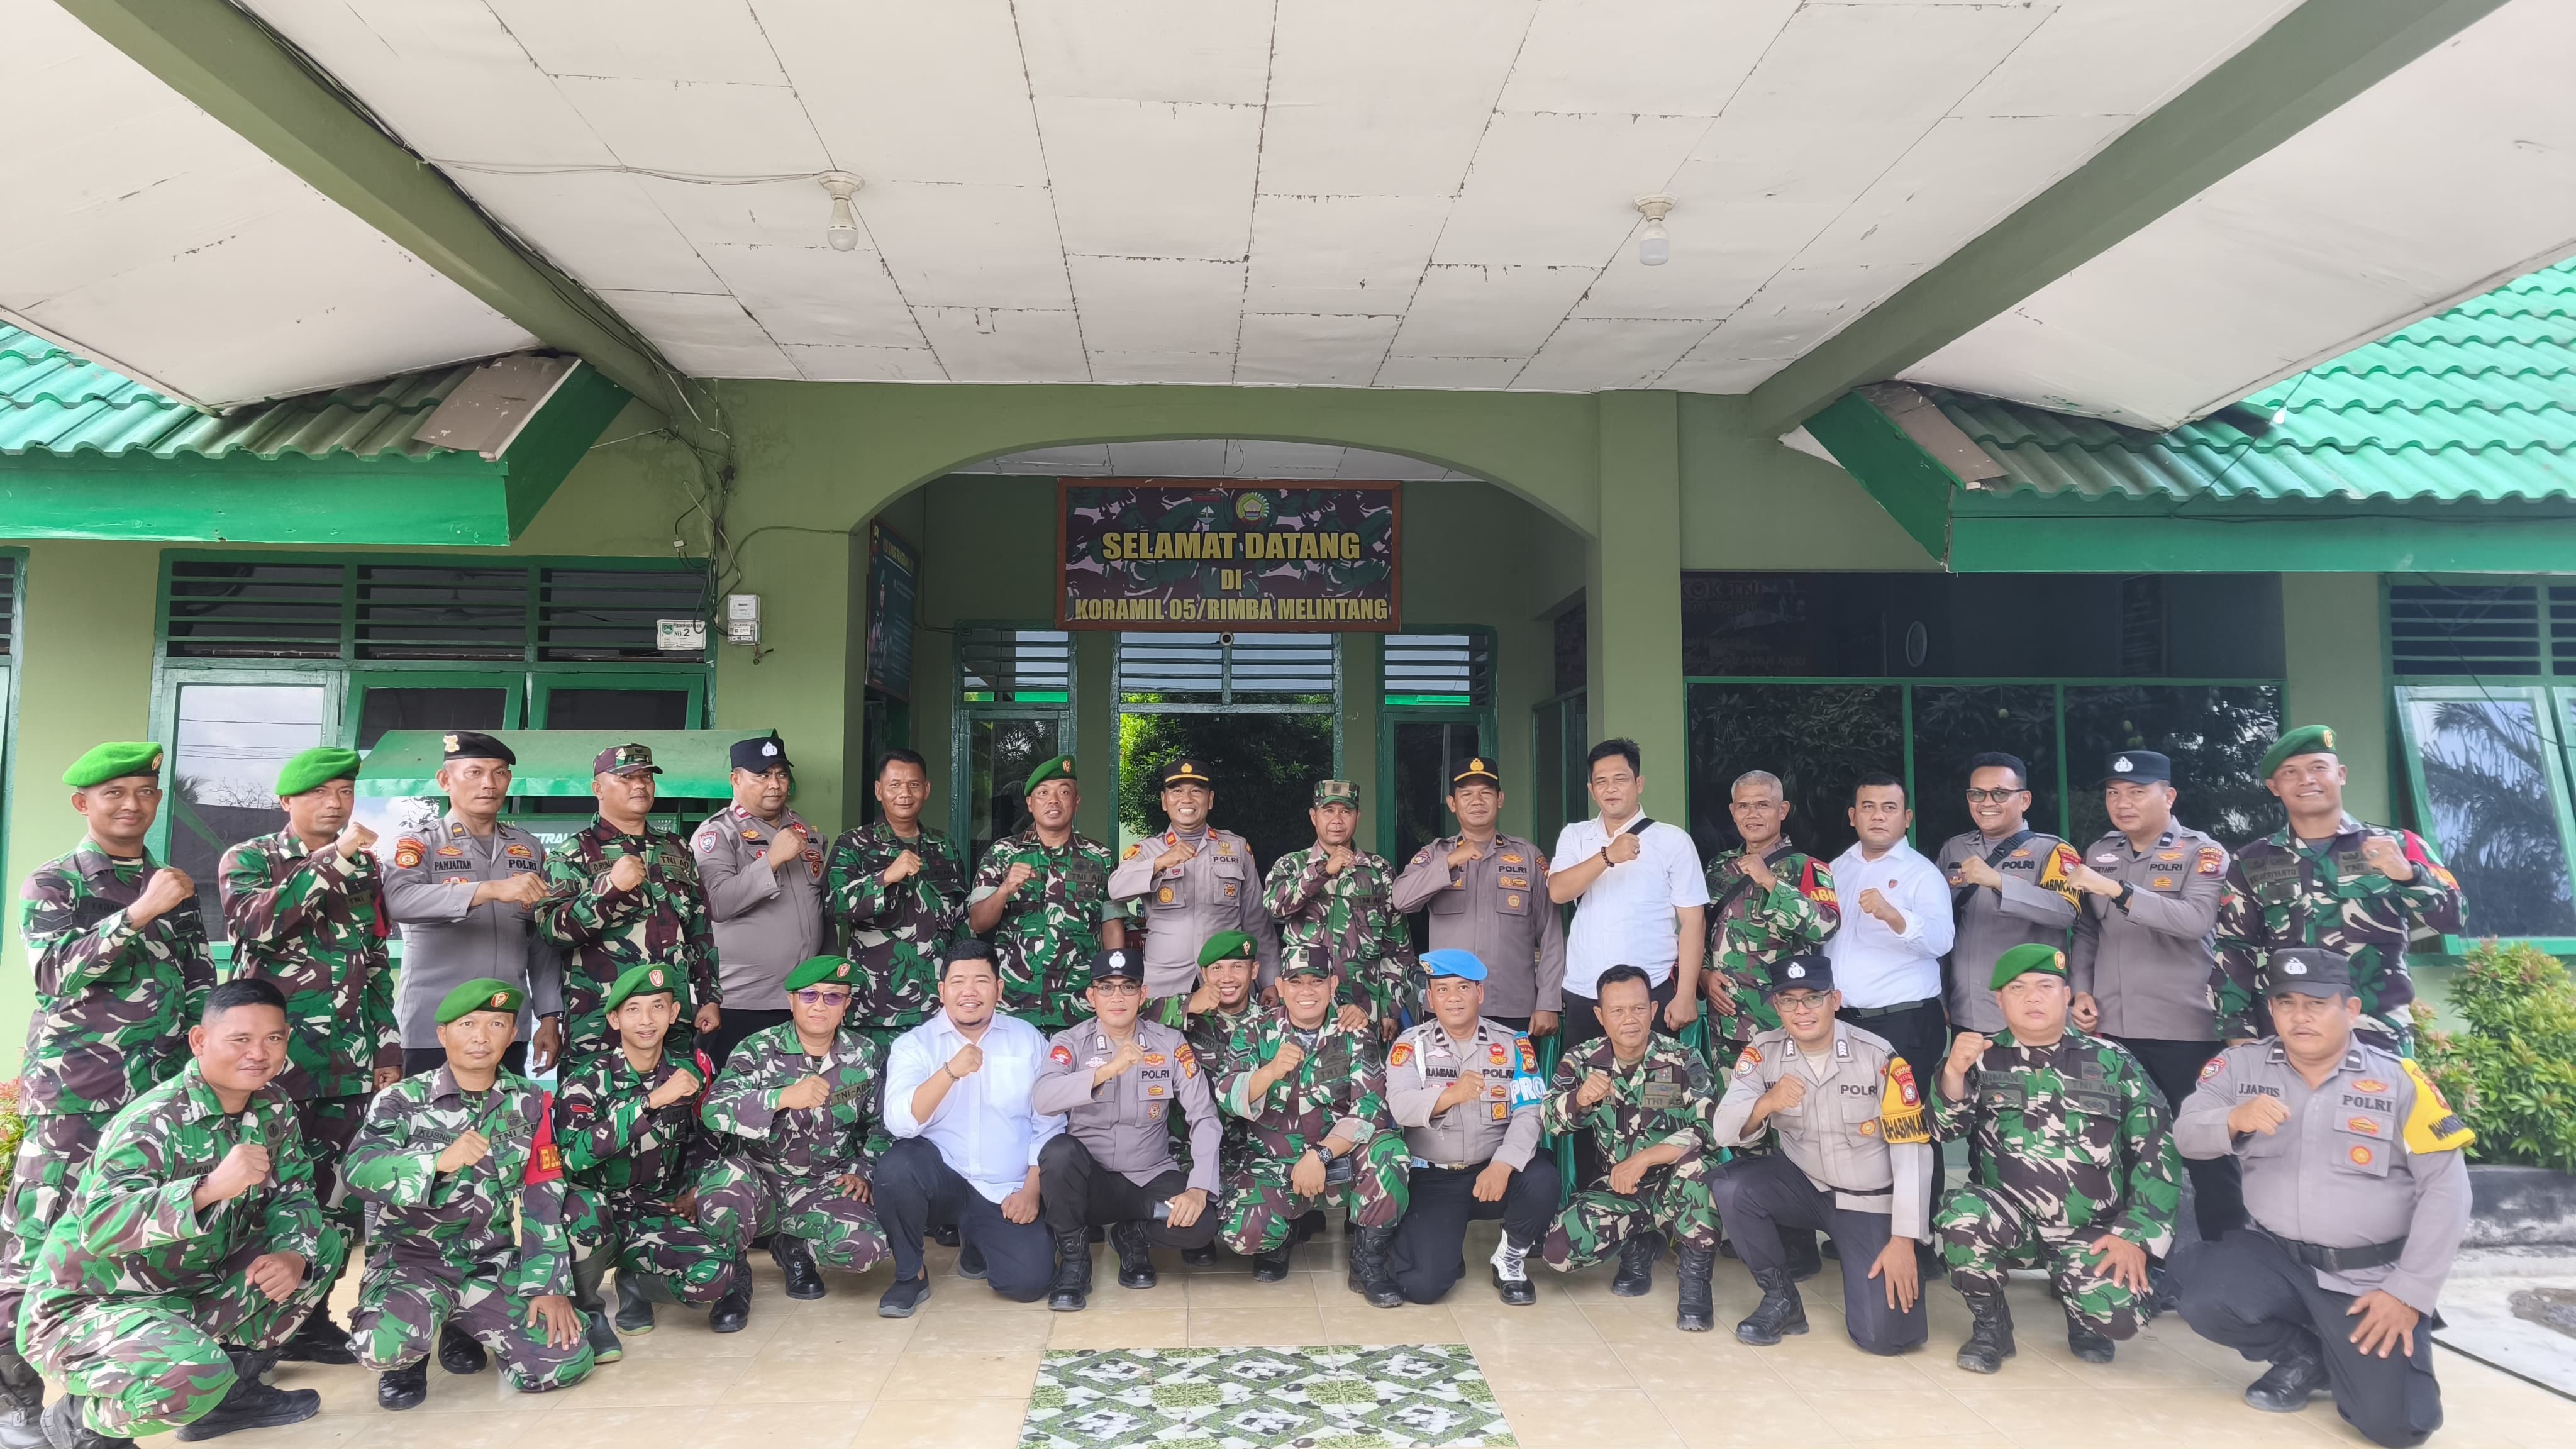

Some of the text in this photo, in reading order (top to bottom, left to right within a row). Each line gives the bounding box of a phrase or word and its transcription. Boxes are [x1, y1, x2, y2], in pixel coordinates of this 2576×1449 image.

[1102, 532, 1360, 560] SELAMAT DATANG
[1221, 569, 1241, 590] DI
[1075, 598, 1388, 621] KORAMIL 05/RIMBA MELINTANG
[435, 860, 472, 872] PANJAITAN
[508, 859, 538, 871] POLRI
[660, 855, 689, 869] TNI AD
[2002, 860, 2035, 870] POLRI
[2149, 863, 2183, 872] POLRI
[2345, 863, 2365, 873] TNI
[1499, 865, 1528, 874] POLRI
[1141, 1070, 1169, 1079] POLRI
[2073, 1080, 2114, 1094] TNI AD
[2343, 1095, 2393, 1113] POLRI
[496, 1124, 536, 1142] TNI AD
